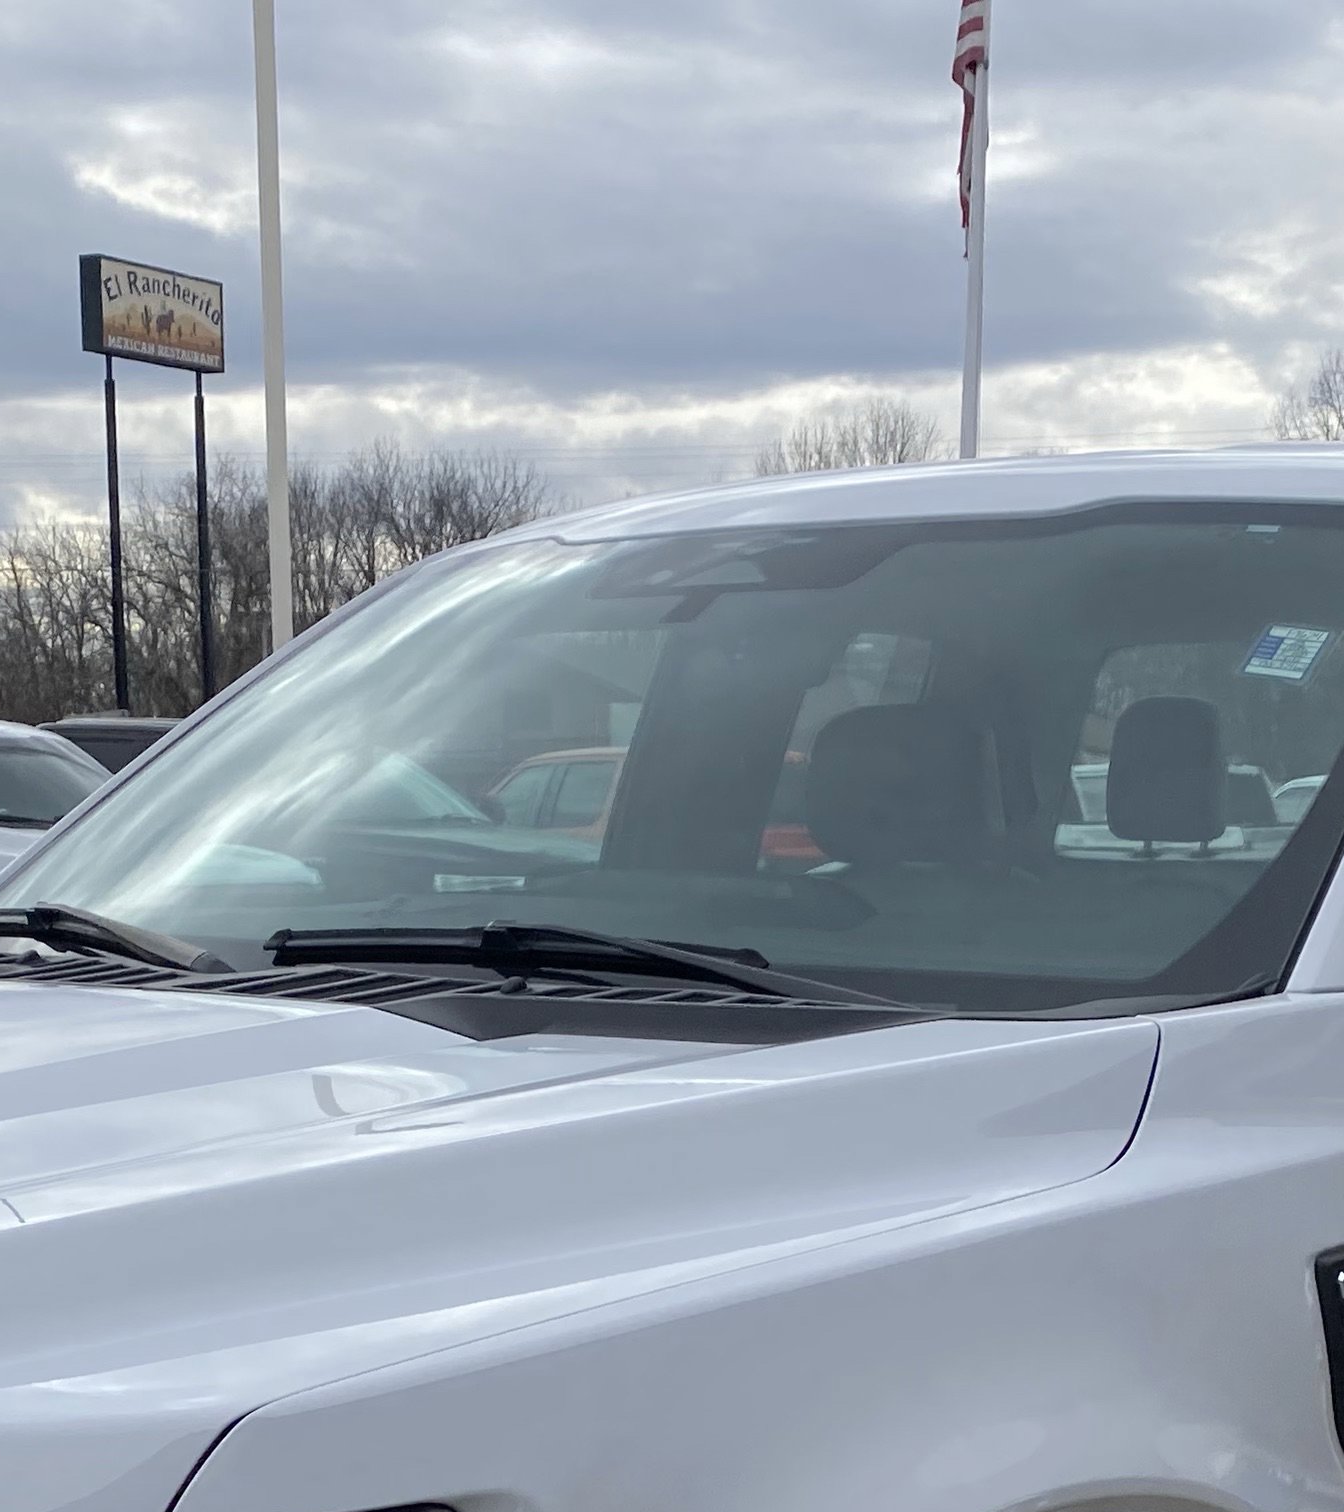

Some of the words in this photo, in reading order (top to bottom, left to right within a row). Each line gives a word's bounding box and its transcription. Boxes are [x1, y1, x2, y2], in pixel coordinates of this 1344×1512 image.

[103, 274, 123, 302] El
[127, 271, 221, 325] Rancherito
[108, 334, 155, 354] MEXICAN
[157, 345, 221, 368] RESTAURANT
